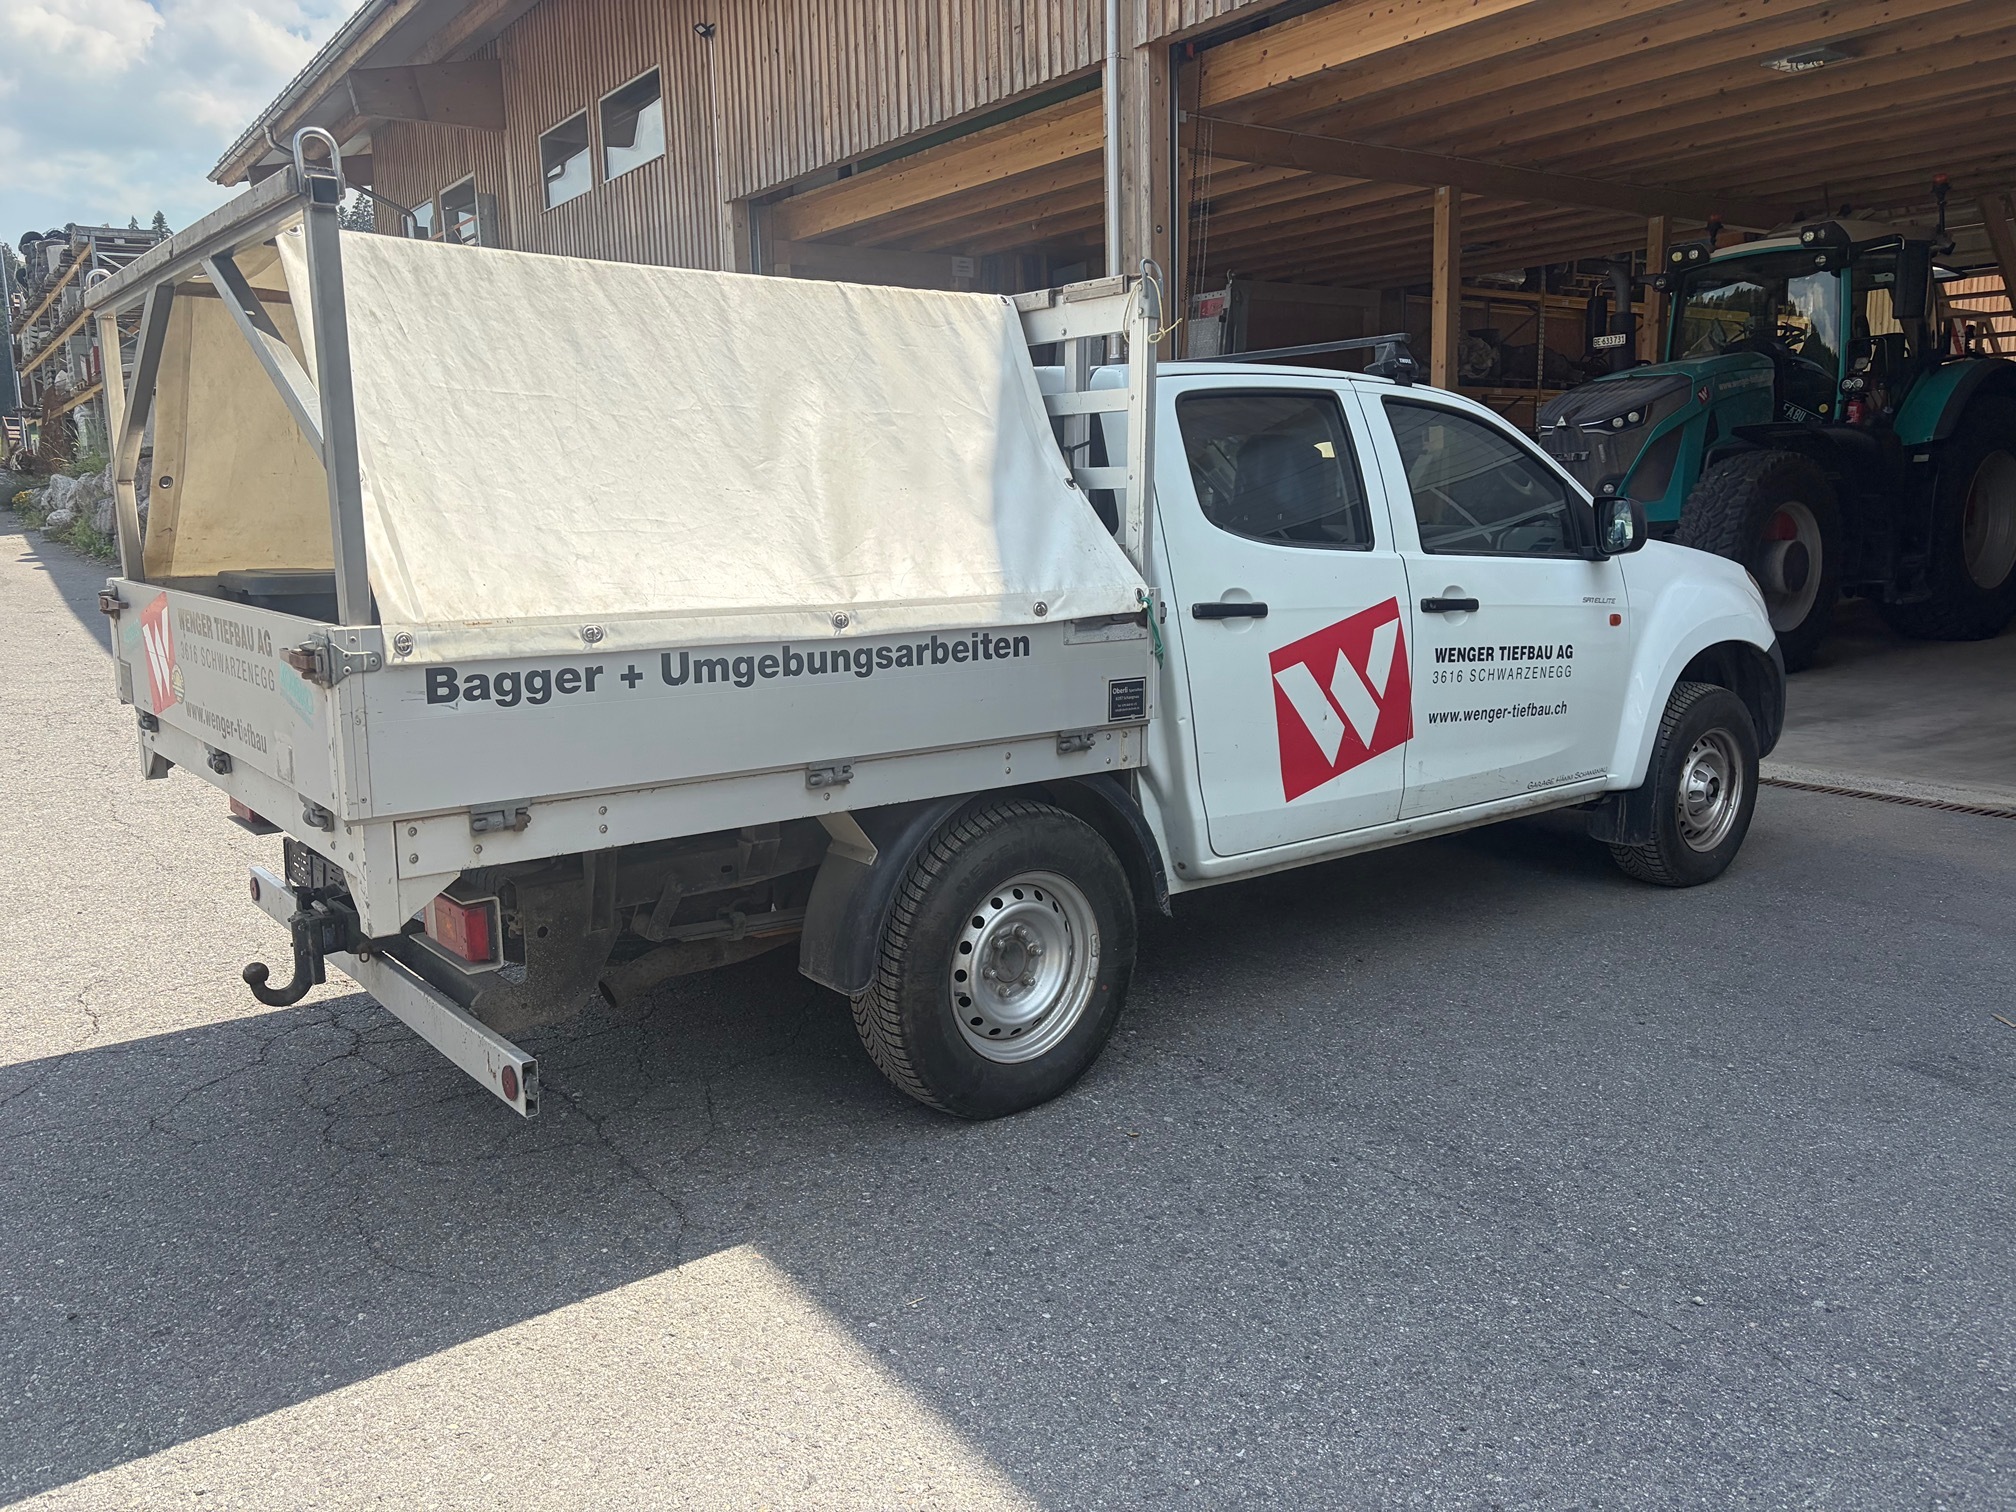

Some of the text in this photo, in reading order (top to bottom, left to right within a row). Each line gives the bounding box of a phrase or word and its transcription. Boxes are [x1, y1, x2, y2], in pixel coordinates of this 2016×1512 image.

[1582, 596, 1617, 605] SATELLITE
[177, 608, 214, 639] WENGER
[214, 617, 255, 652] TIEFBAU
[257, 628, 273, 657] AG
[200, 646, 275, 691] SCHWARZENEGG
[425, 665, 604, 707] Bagger
[660, 632, 1031, 688] Umgebungsarbeiten
[1434, 644, 1574, 663] WENGER TIEFBAU AG
[1432, 665, 1572, 684] 3616 SCHWARZENEGG
[1273, 617, 1399, 768] W
[1428, 701, 1568, 724] www.wenger-tiefbau.ch
